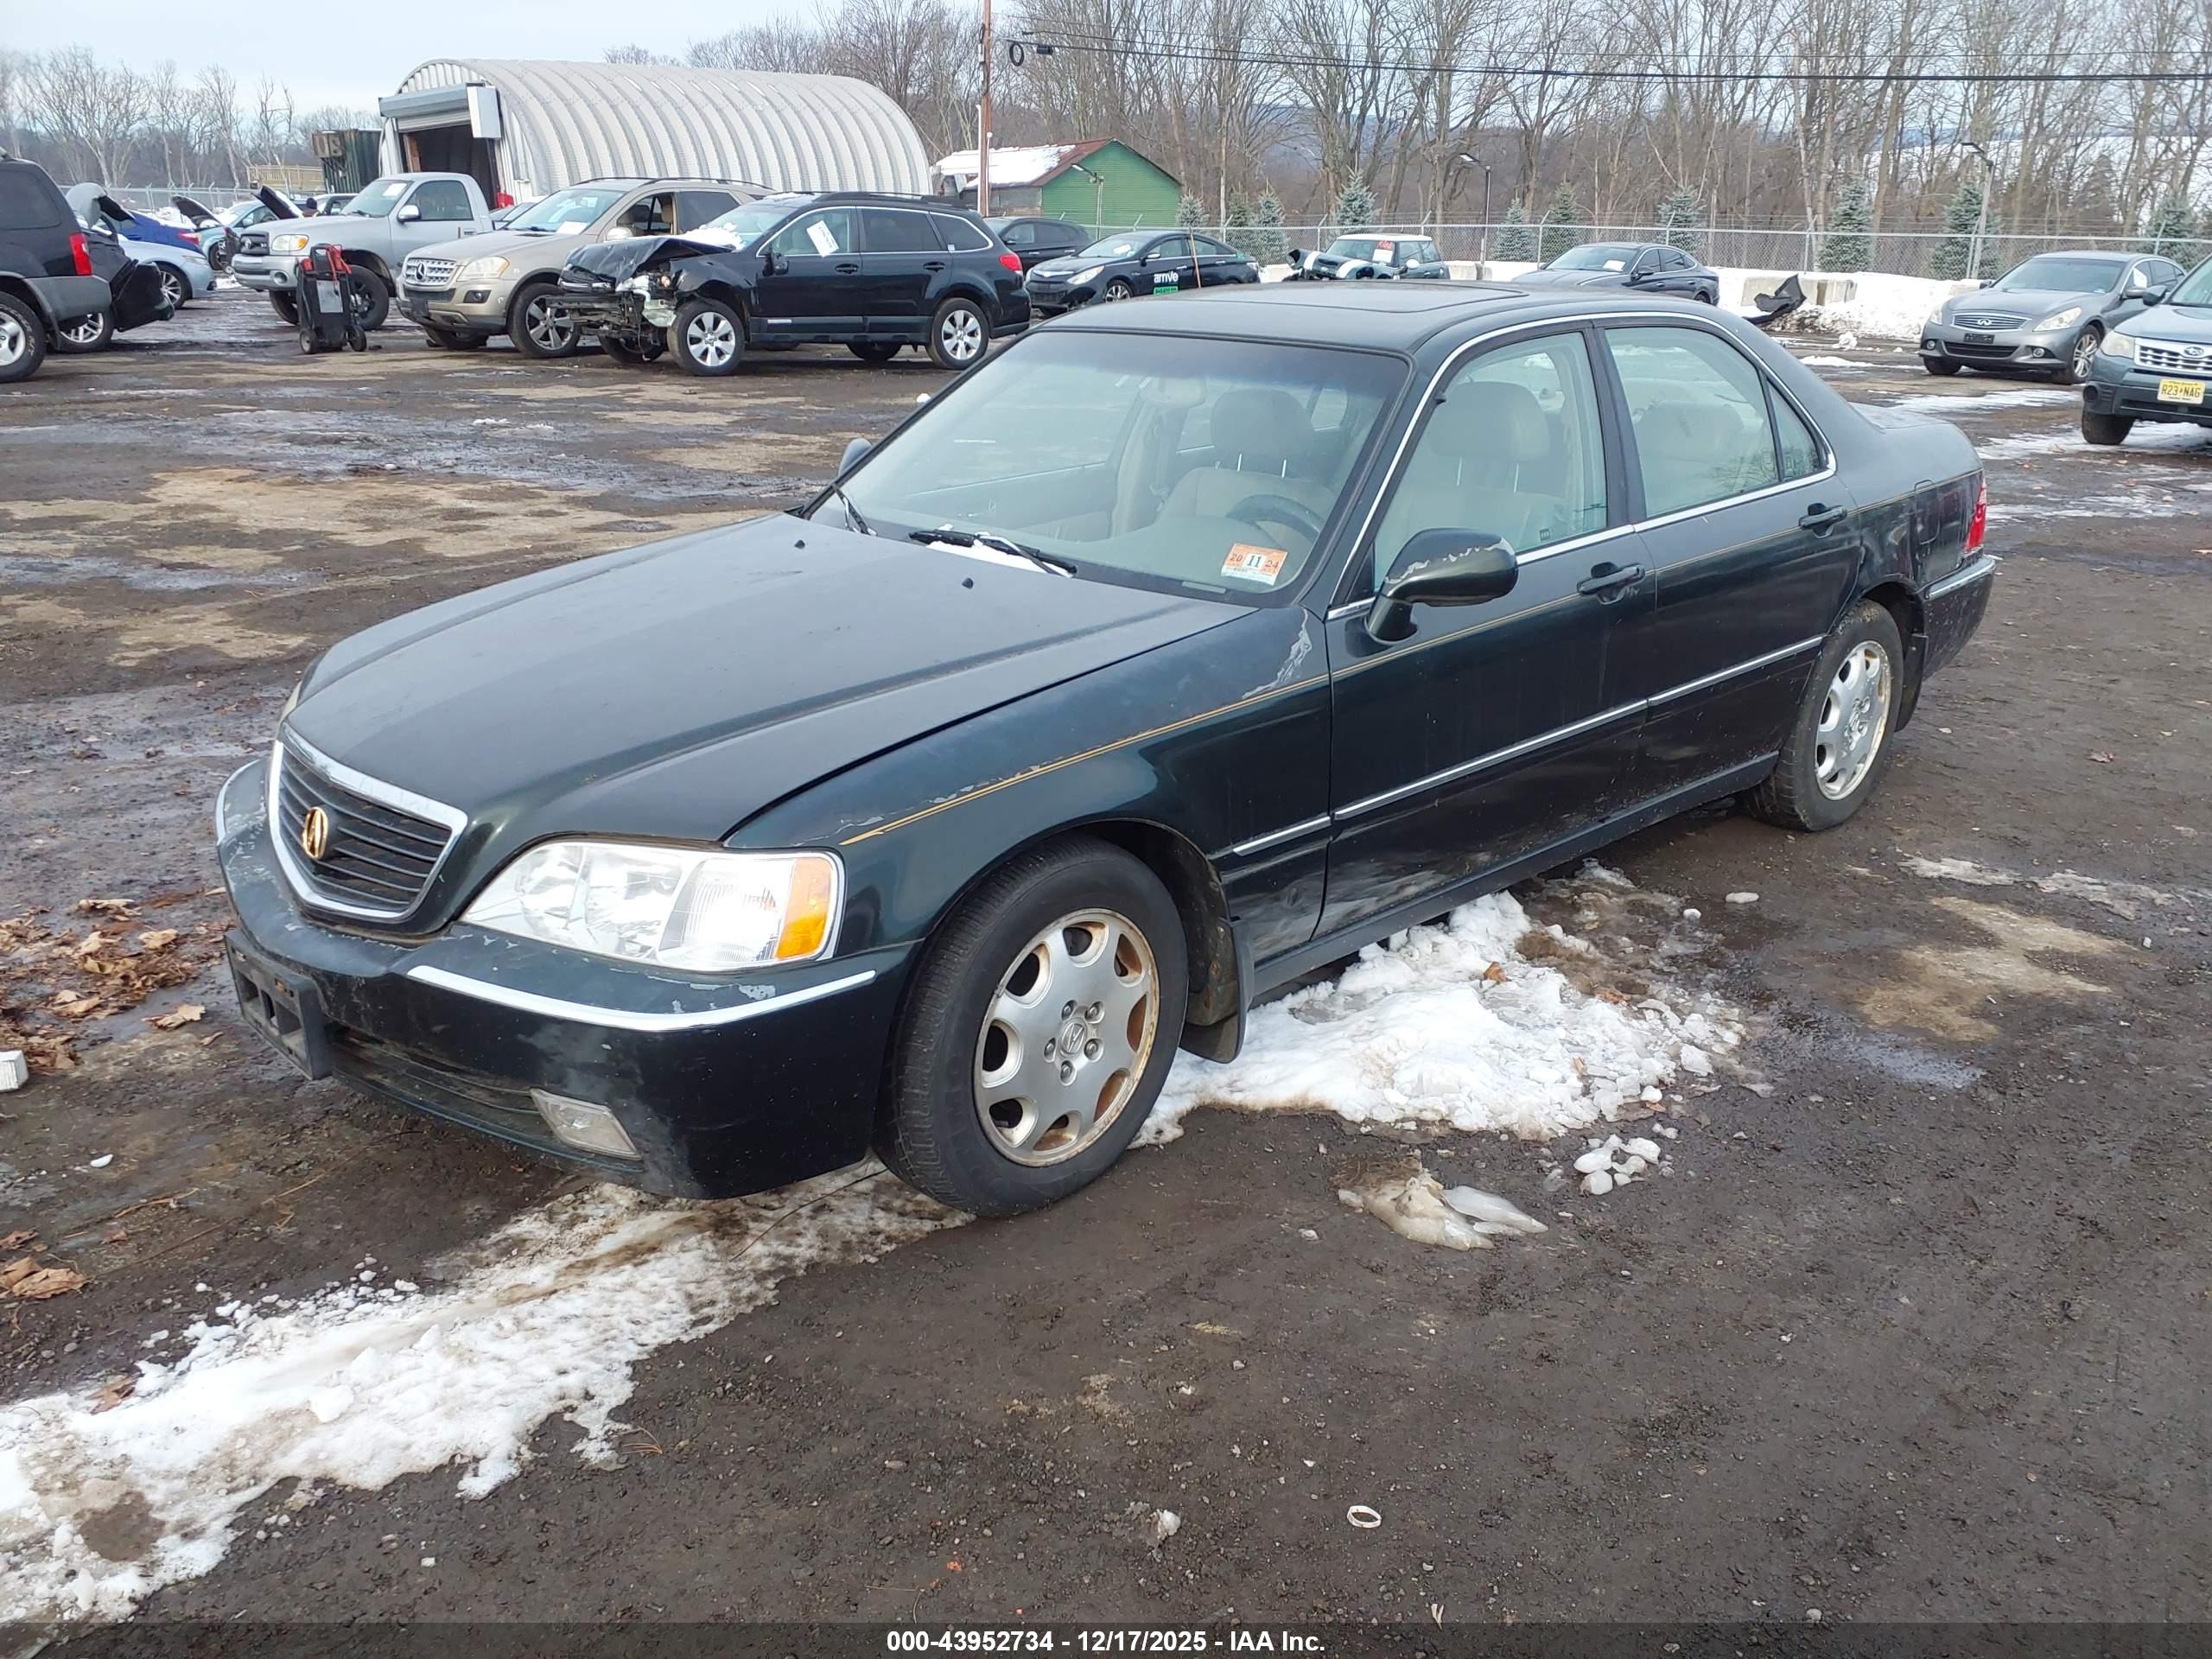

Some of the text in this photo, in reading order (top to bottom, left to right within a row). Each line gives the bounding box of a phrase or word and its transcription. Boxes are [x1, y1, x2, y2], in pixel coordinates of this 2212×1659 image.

[1154, 270, 1179, 283] arrive
[1230, 553, 1280, 569] 20 11 24
